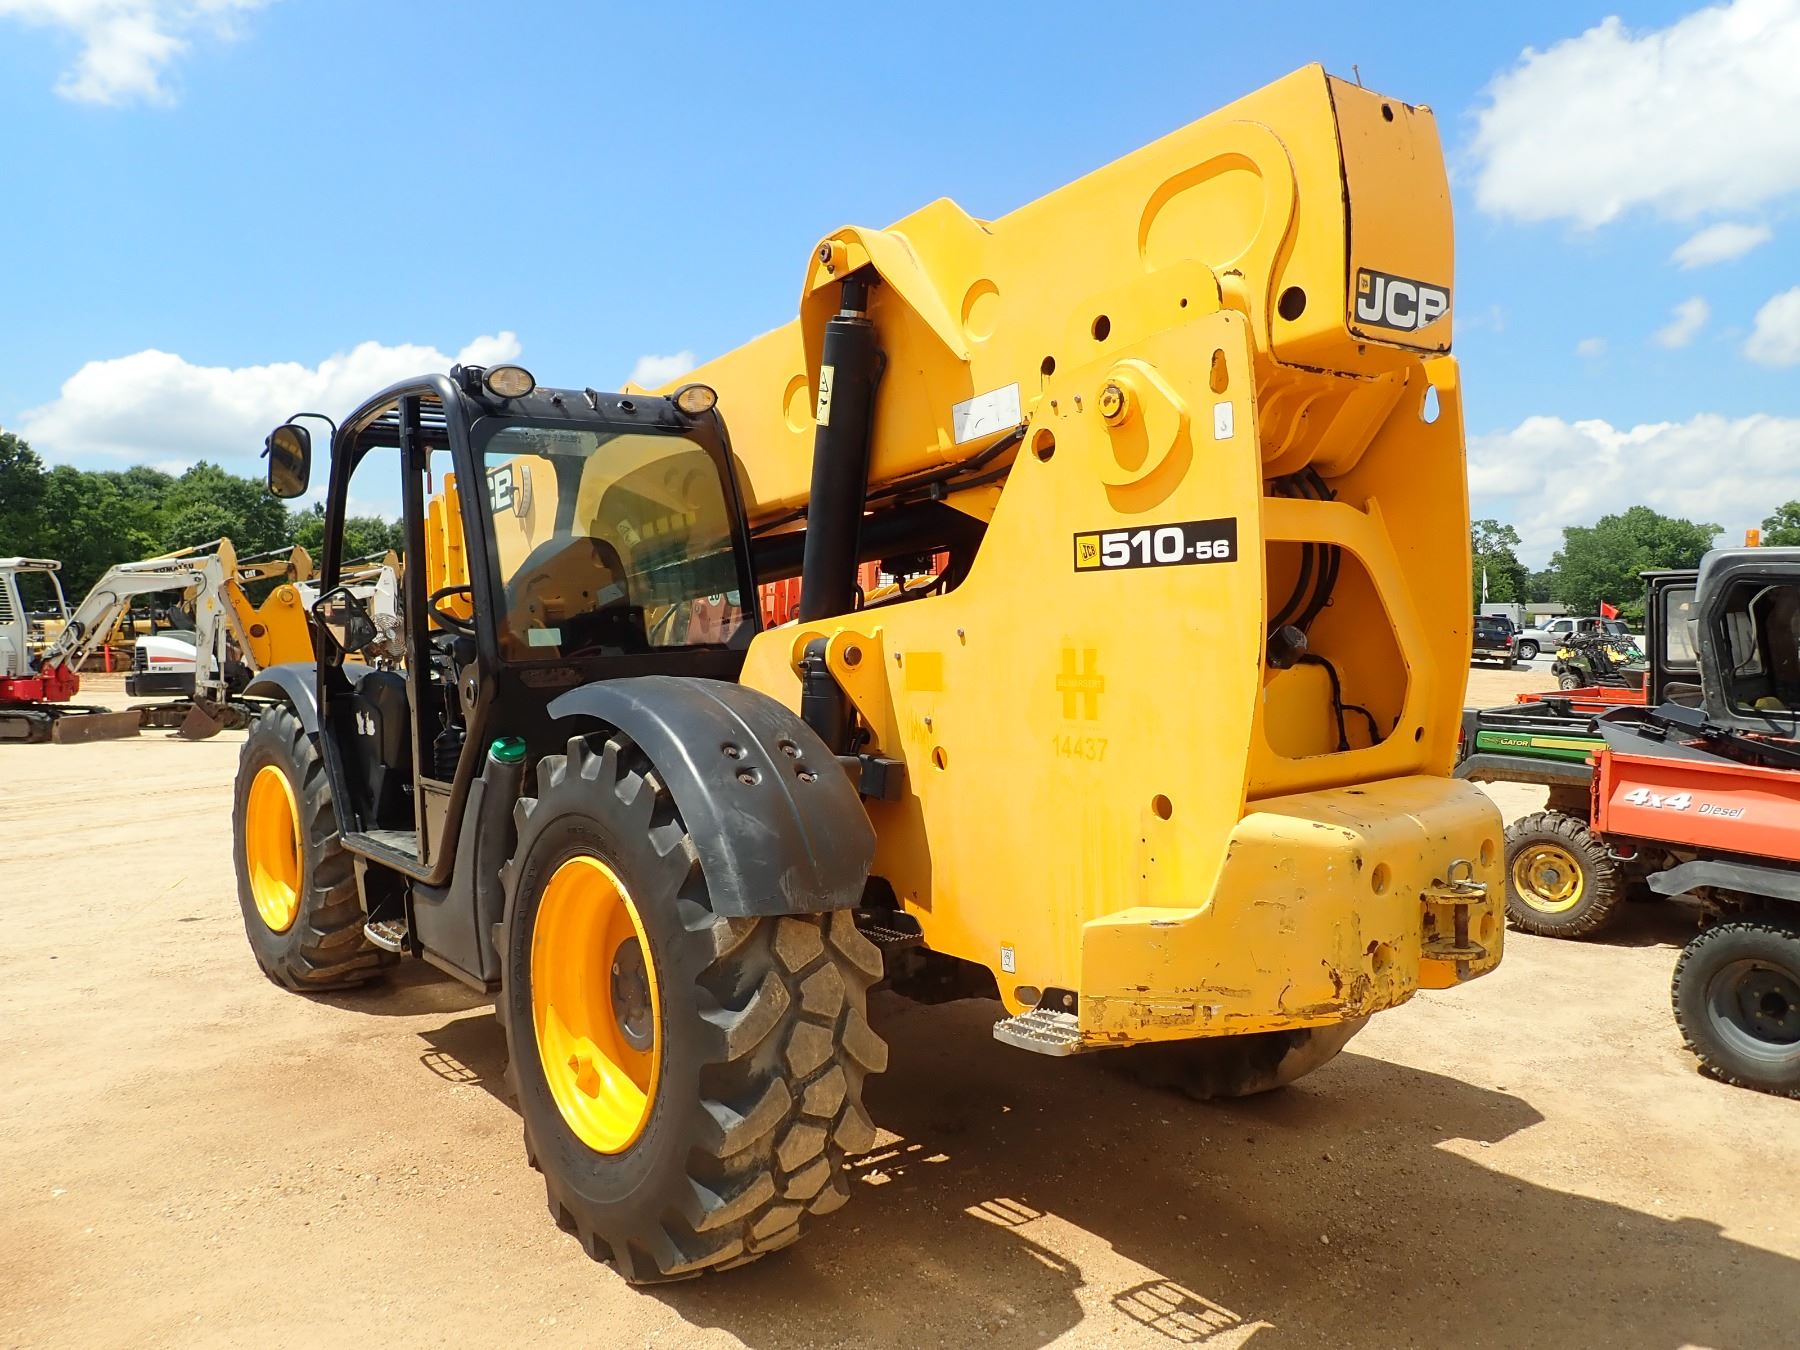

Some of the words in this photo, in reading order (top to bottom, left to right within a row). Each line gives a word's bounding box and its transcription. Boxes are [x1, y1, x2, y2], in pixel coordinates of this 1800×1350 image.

[1080, 543, 1096, 561] JCB
[244, 569, 256, 579] CAT
[1052, 734, 1108, 762] 14437
[1500, 738, 1529, 747] GATOR
[1624, 788, 1692, 812] 4x4
[1698, 803, 1744, 818] Diesel
